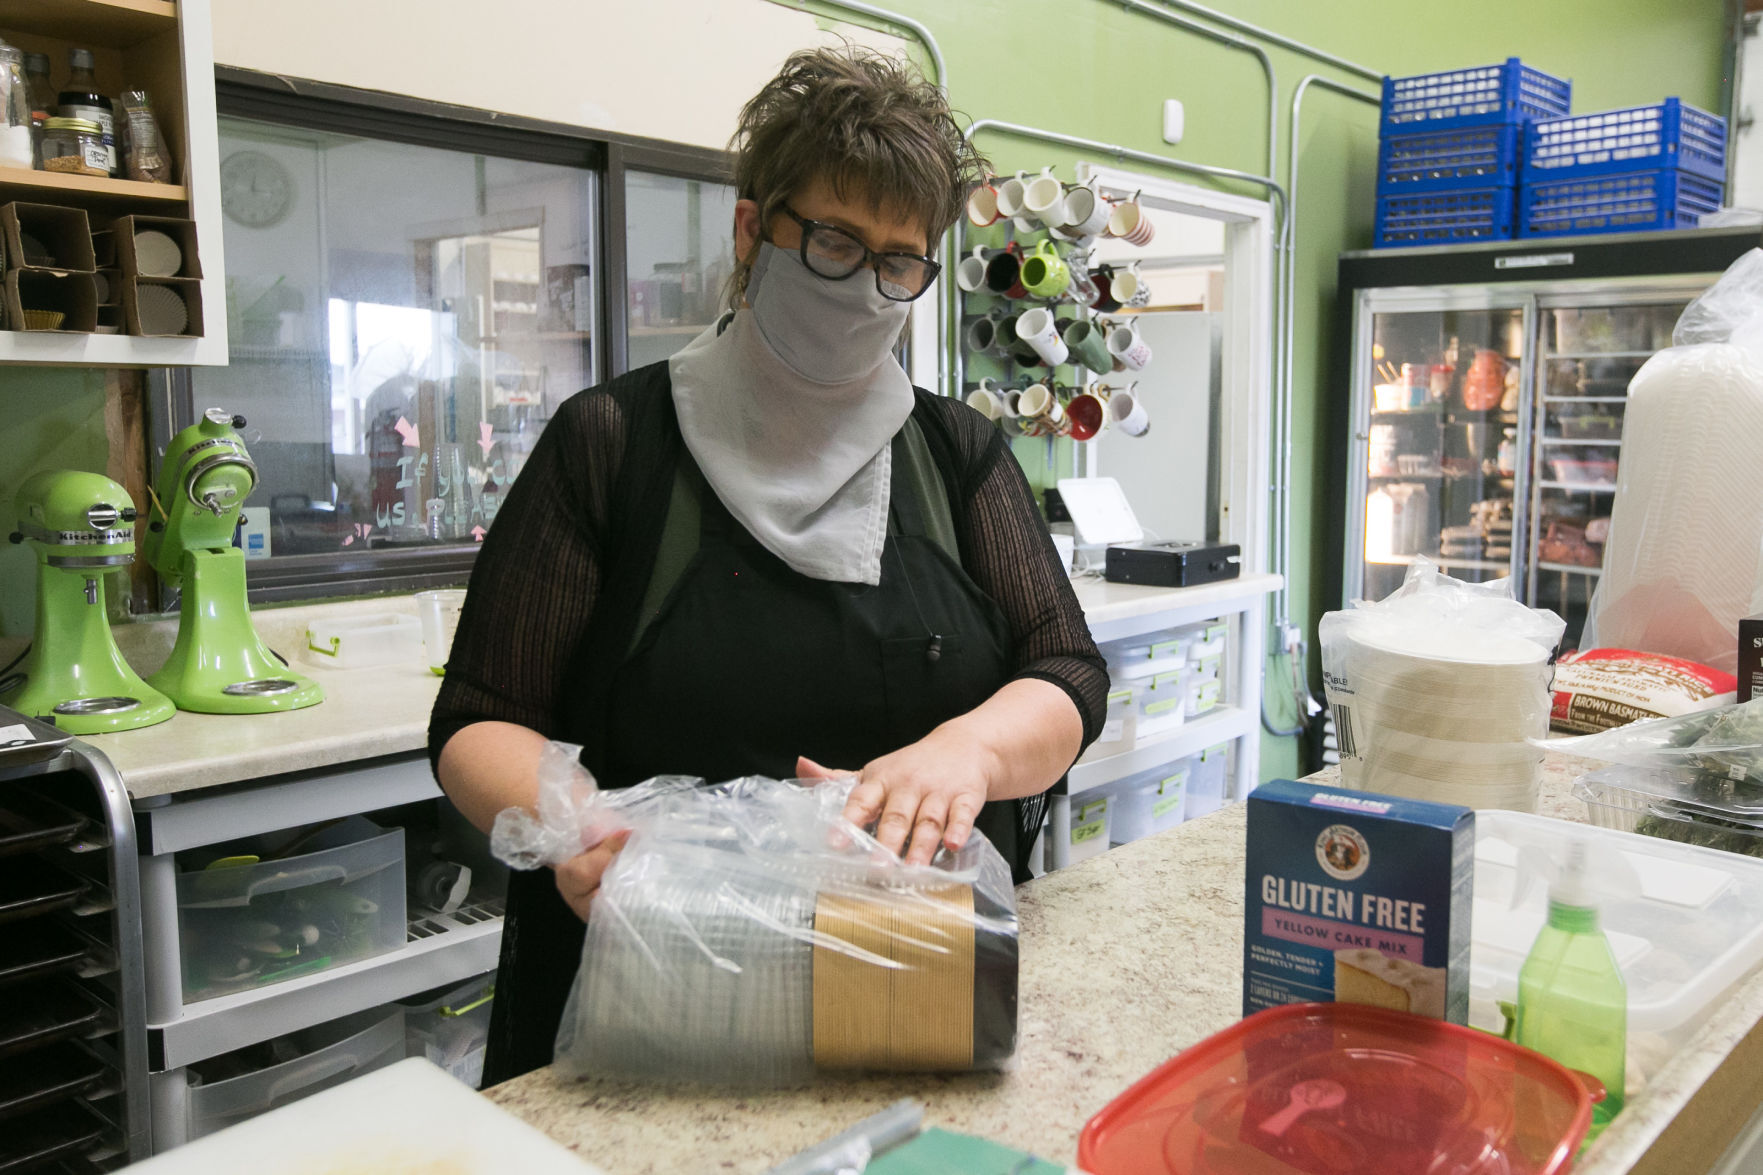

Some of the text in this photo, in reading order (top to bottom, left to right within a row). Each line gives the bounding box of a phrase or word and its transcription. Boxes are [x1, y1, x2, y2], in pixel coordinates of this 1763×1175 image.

[396, 452, 429, 490] If
[60, 530, 131, 541] KitchenAid
[1574, 695, 1608, 713] BROWN
[1262, 874, 1426, 934] GLUTEN FREE
[1275, 918, 1407, 955] YELLOW CAKE MIX
[1250, 953, 1321, 975] PERFECTLY MOIST
